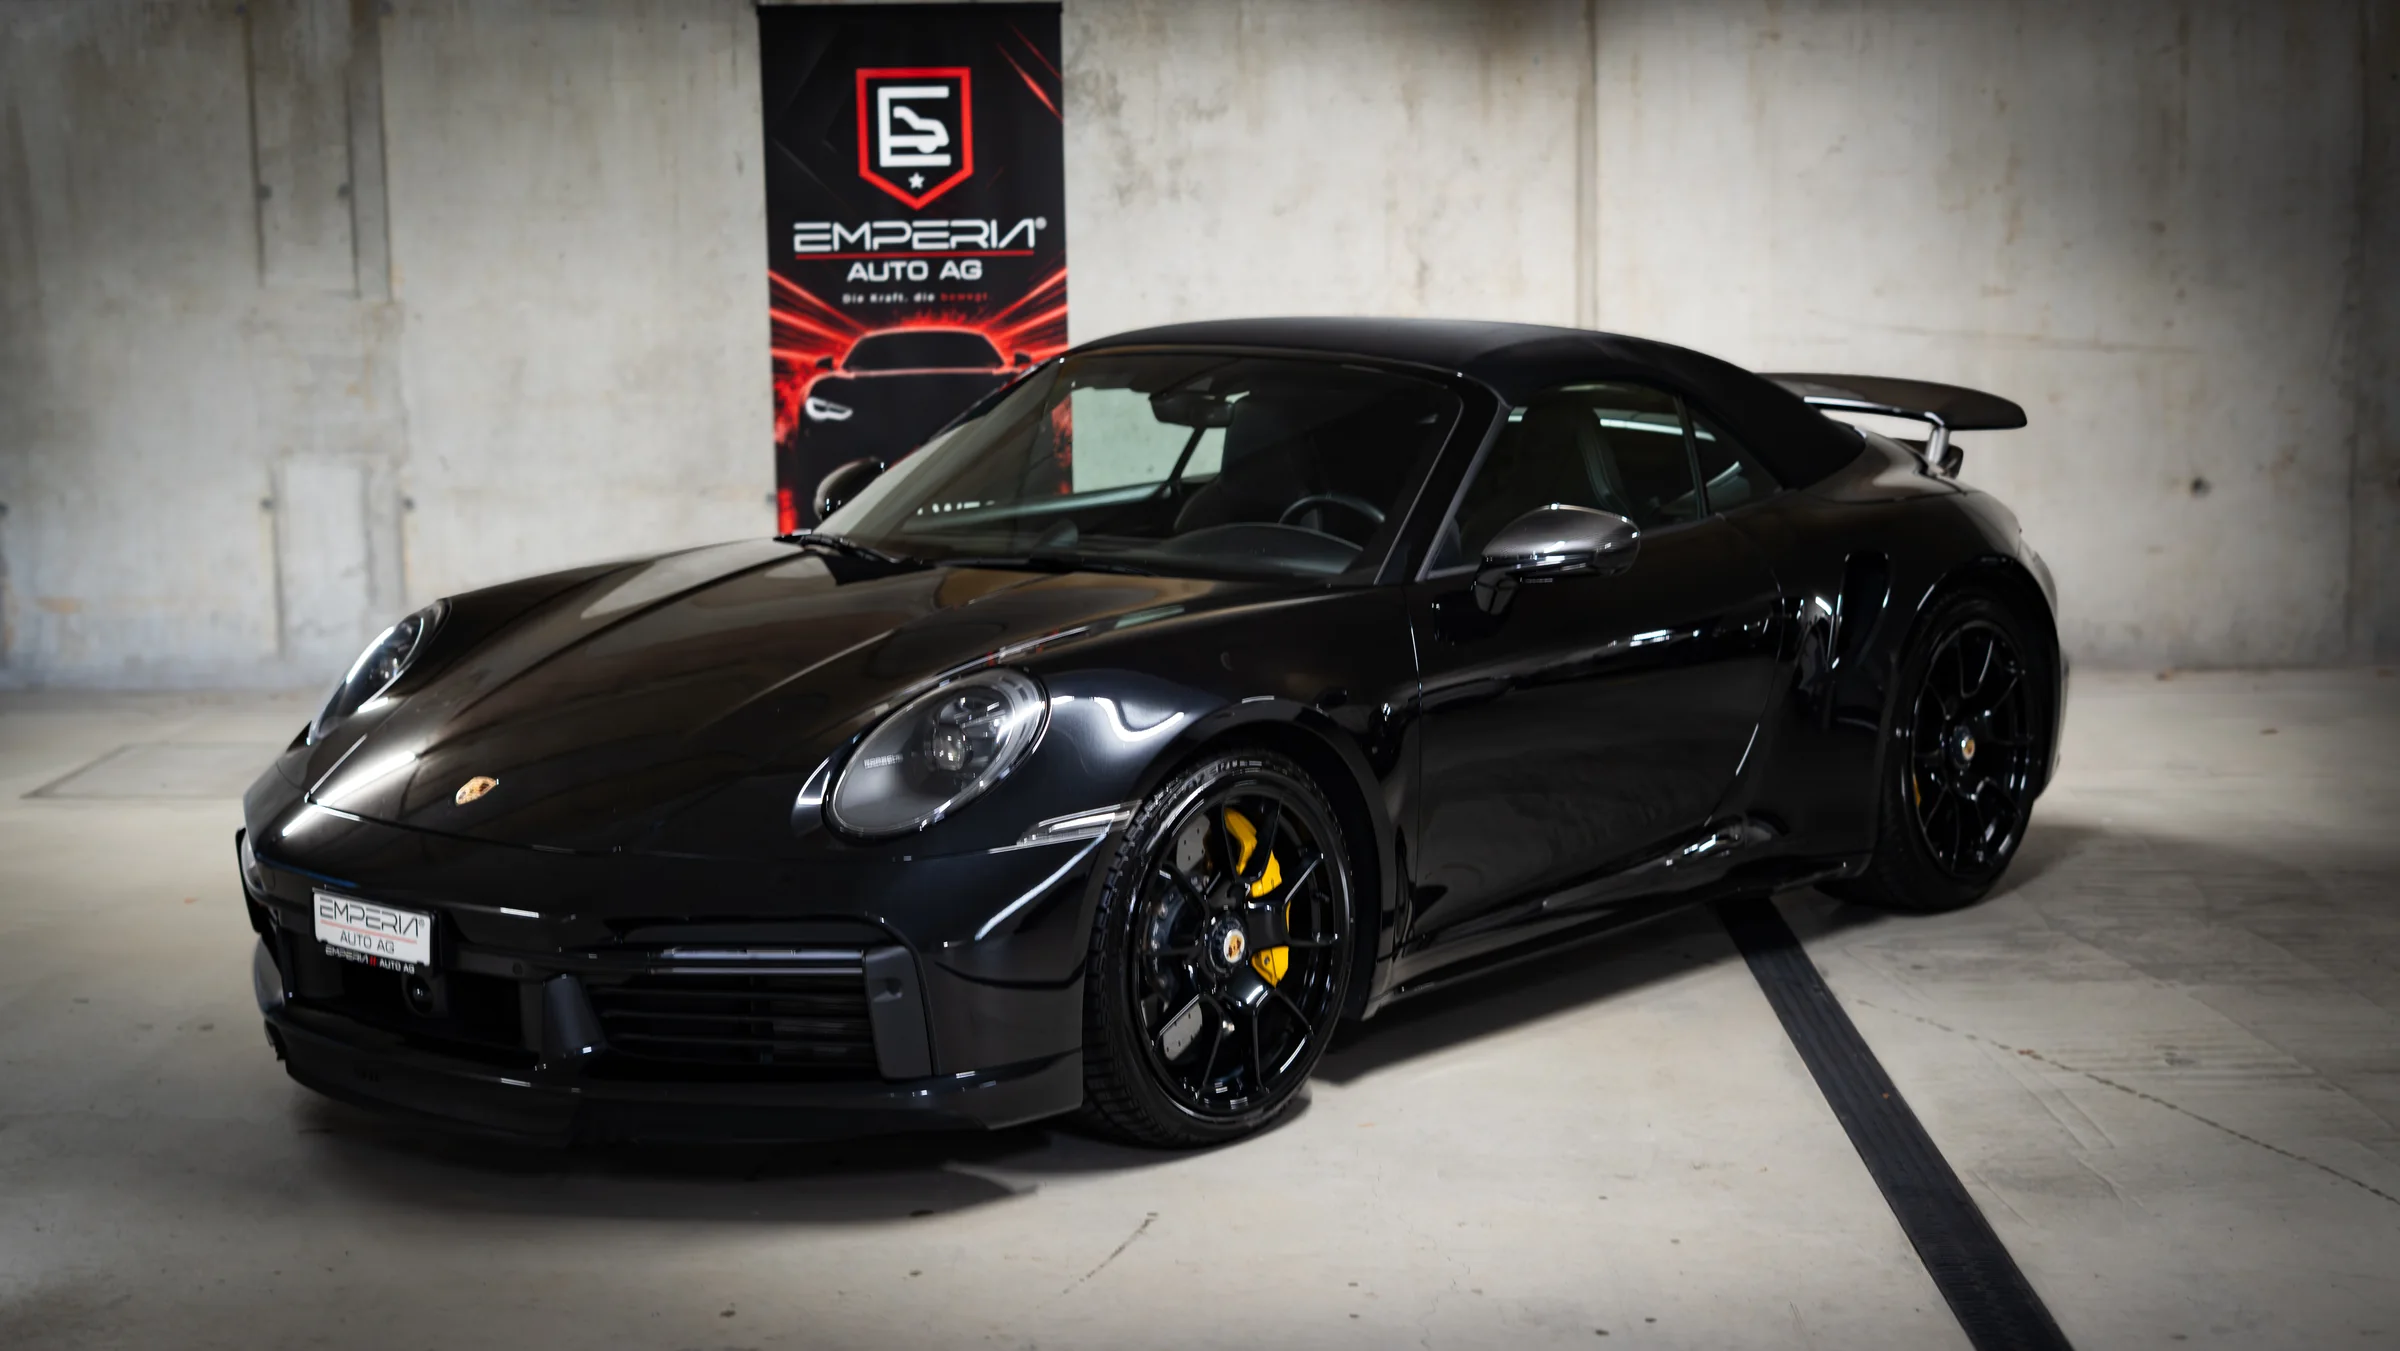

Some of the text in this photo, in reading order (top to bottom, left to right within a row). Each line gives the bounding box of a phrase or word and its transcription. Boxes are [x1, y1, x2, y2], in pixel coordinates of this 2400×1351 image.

[847, 259, 983, 282] AUTO AG
[842, 293, 865, 304] Die
[913, 291, 936, 302] die
[340, 930, 395, 954] AUTO AG
[379, 958, 401, 972] AUTO
[403, 963, 415, 975] AG
